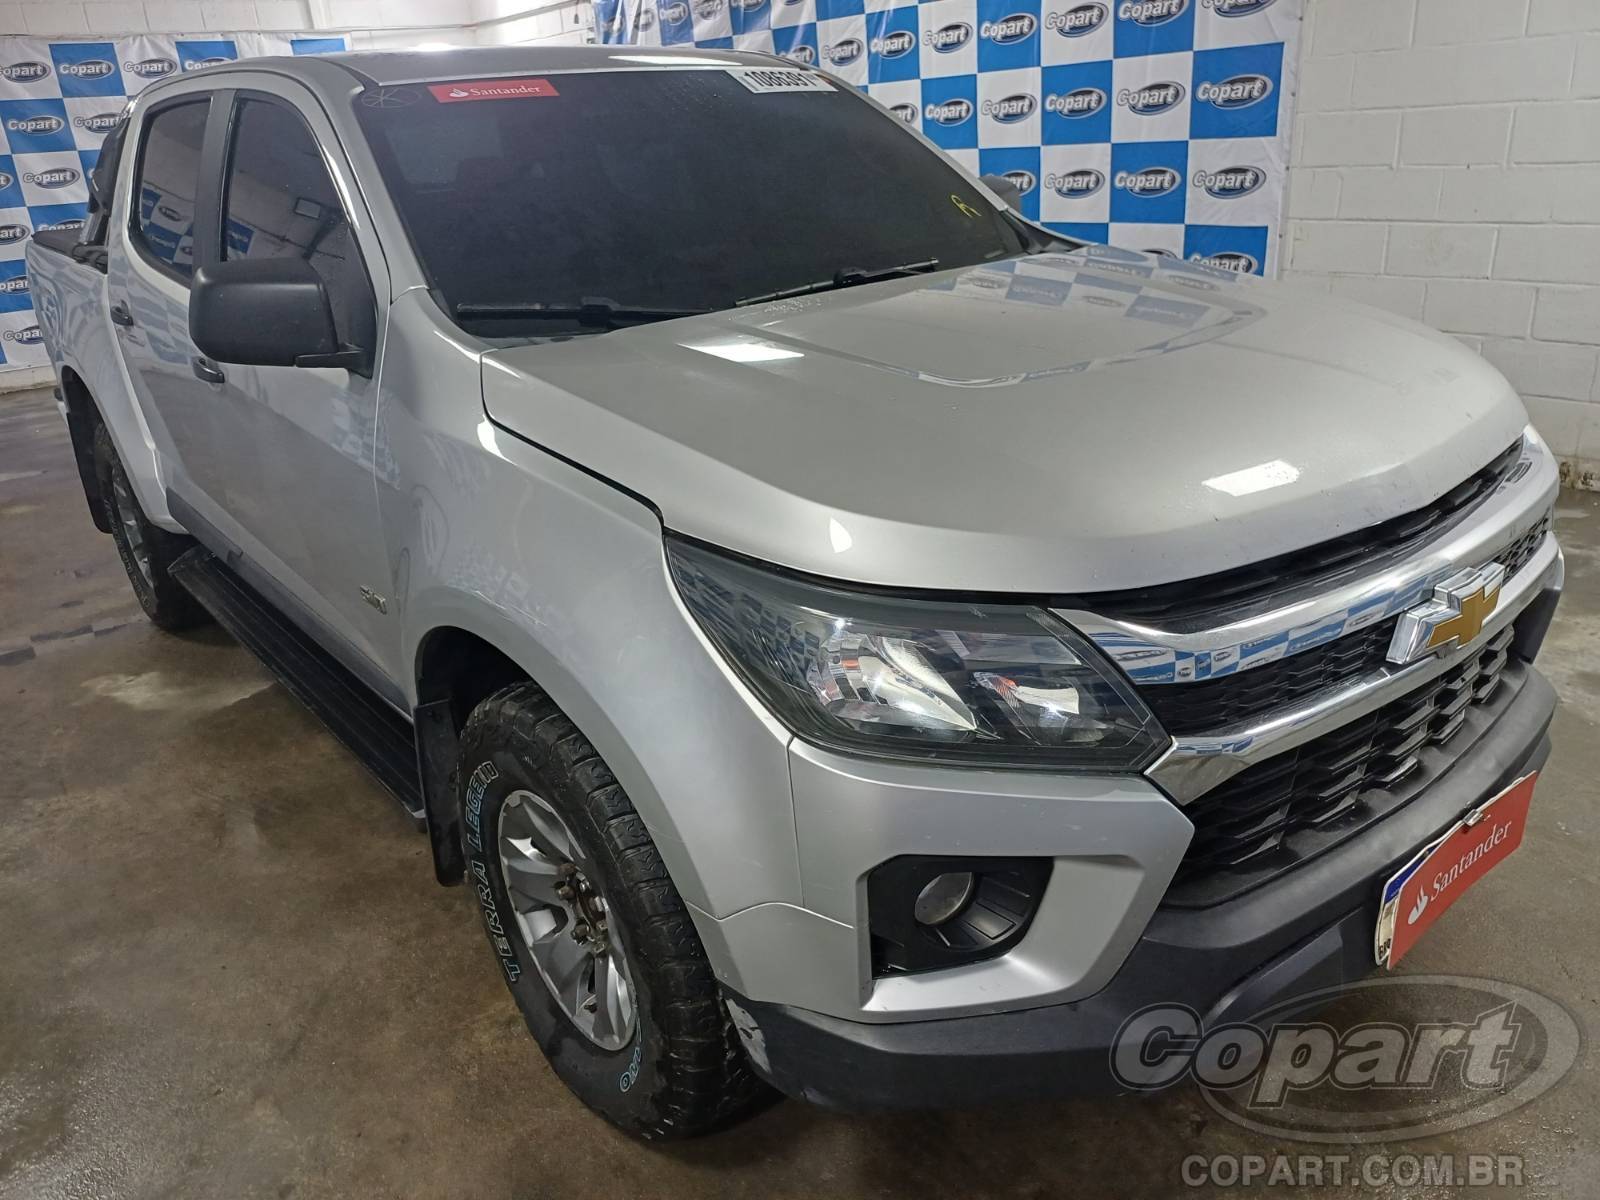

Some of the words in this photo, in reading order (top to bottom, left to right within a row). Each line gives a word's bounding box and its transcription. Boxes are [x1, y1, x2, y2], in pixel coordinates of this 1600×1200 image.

[1045, 8, 1100, 31] Copart
[1119, 0, 1179, 24] Copart
[923, 25, 967, 48] Copart
[980, 17, 1030, 40] Copart
[822, 43, 857, 62] Copart
[871, 35, 910, 54] Copart
[0, 64, 43, 77] opart
[60, 63, 108, 75] Copart
[124, 60, 170, 72] Copart
[744, 71, 816, 87] 1086391
[470, 86, 541, 96] Santander
[1117, 86, 1176, 108] Copart
[1197, 78, 1263, 103] Copart
[925, 103, 967, 121] Copart
[981, 98, 1030, 119] Copart
[1045, 90, 1099, 113] Copart
[8, 119, 57, 132] Copart
[24, 171, 72, 185] Copart
[1045, 171, 1098, 191] Copart
[1114, 170, 1172, 191] Copart
[1193, 169, 1254, 191] Copart
[466, 761, 499, 853] LEGEND
[1430, 820, 1512, 902] Santander
[471, 860, 520, 981] TERRA
